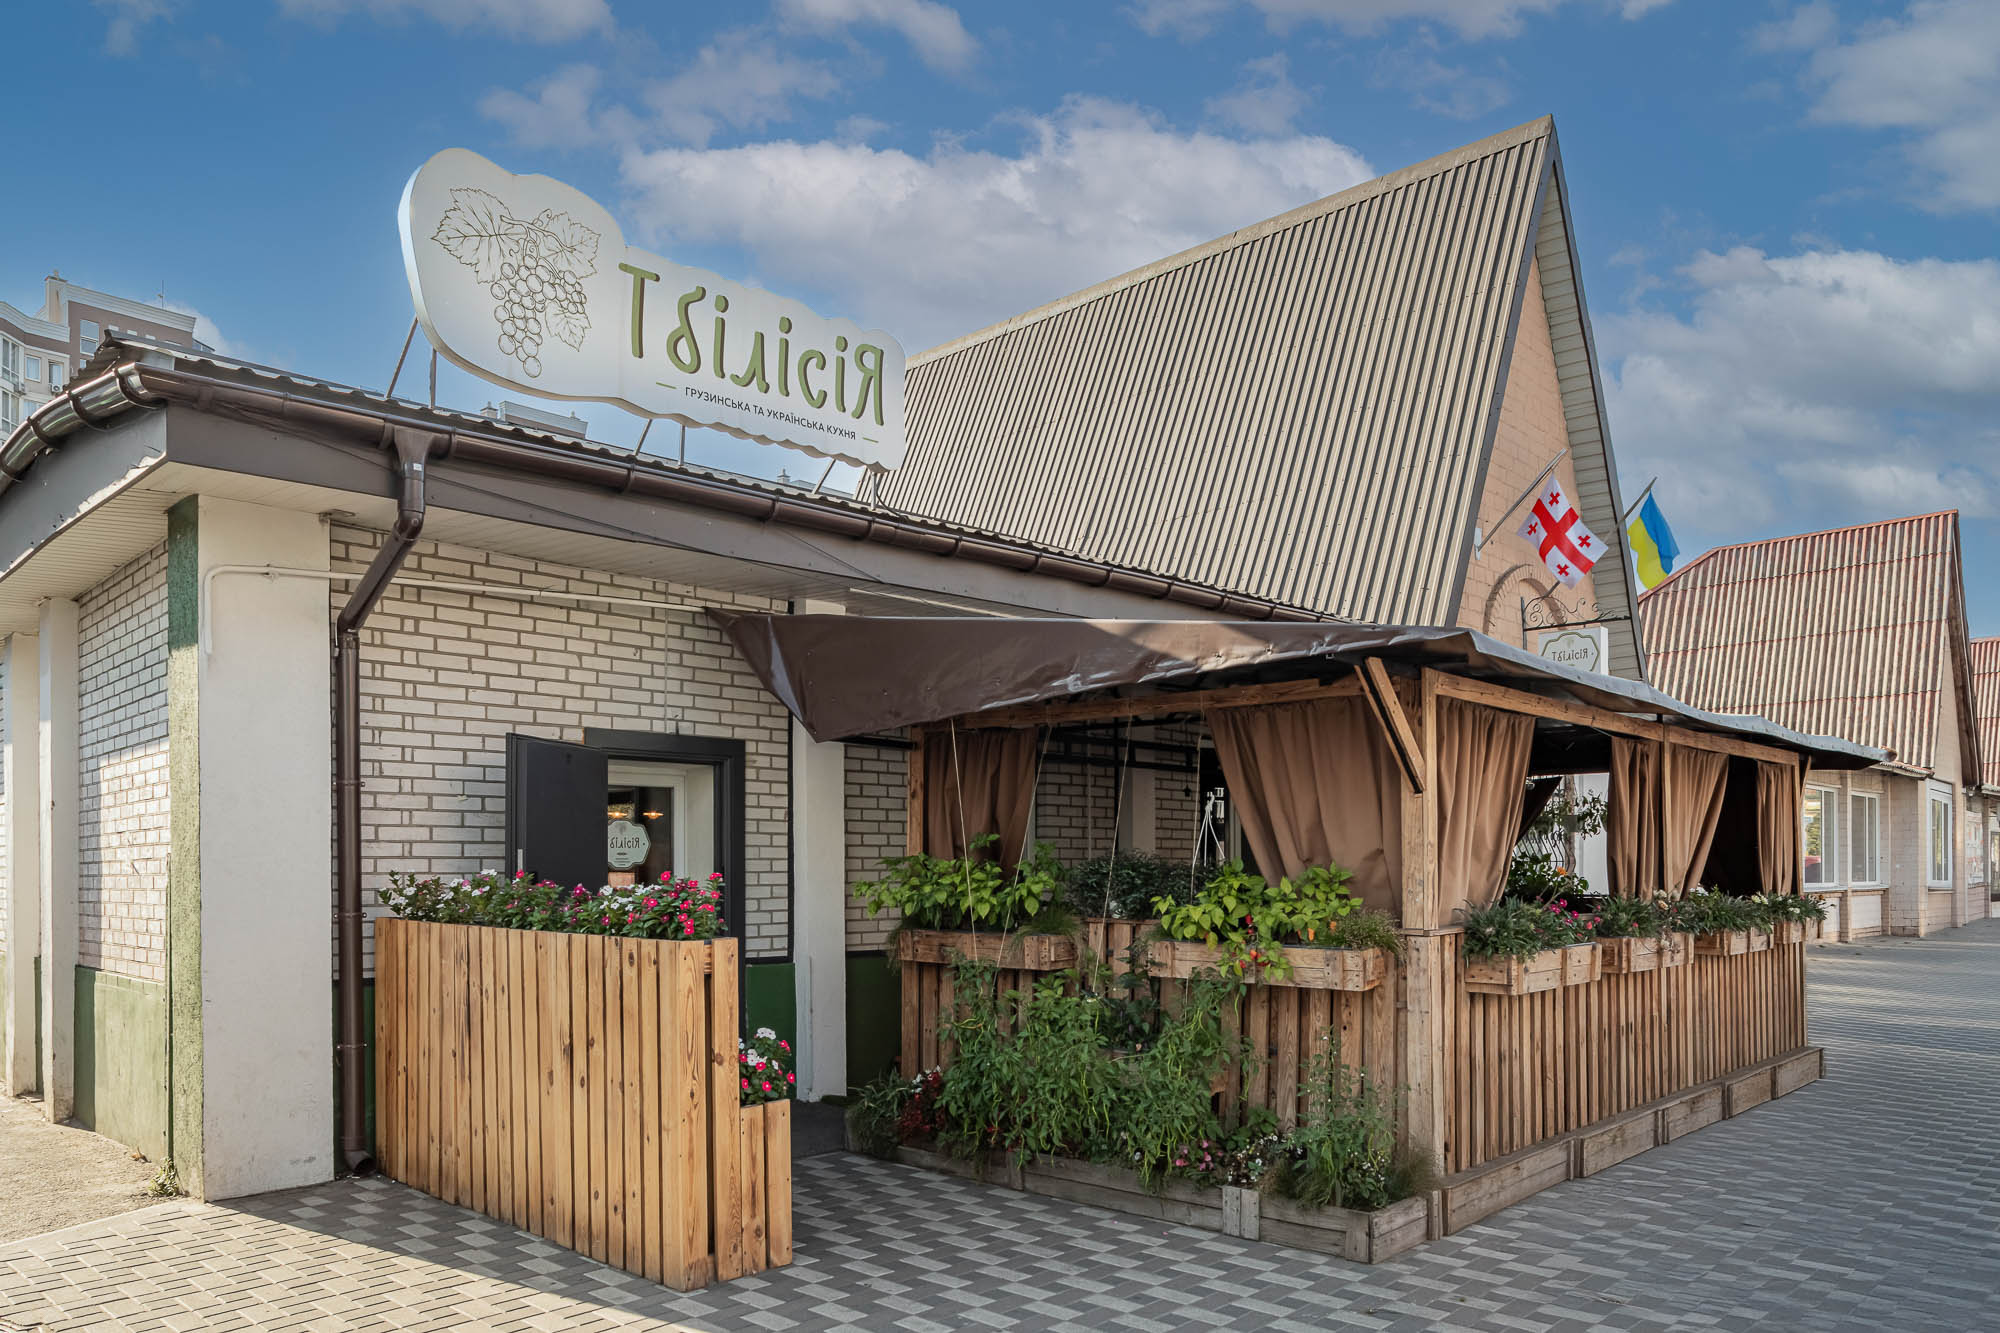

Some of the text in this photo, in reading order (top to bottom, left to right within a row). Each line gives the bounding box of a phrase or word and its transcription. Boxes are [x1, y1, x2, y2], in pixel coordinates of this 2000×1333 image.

[685, 386, 856, 440] ГРУЗИНСЬКА ТА УКРАЇНСЬКА КУХНЯ
